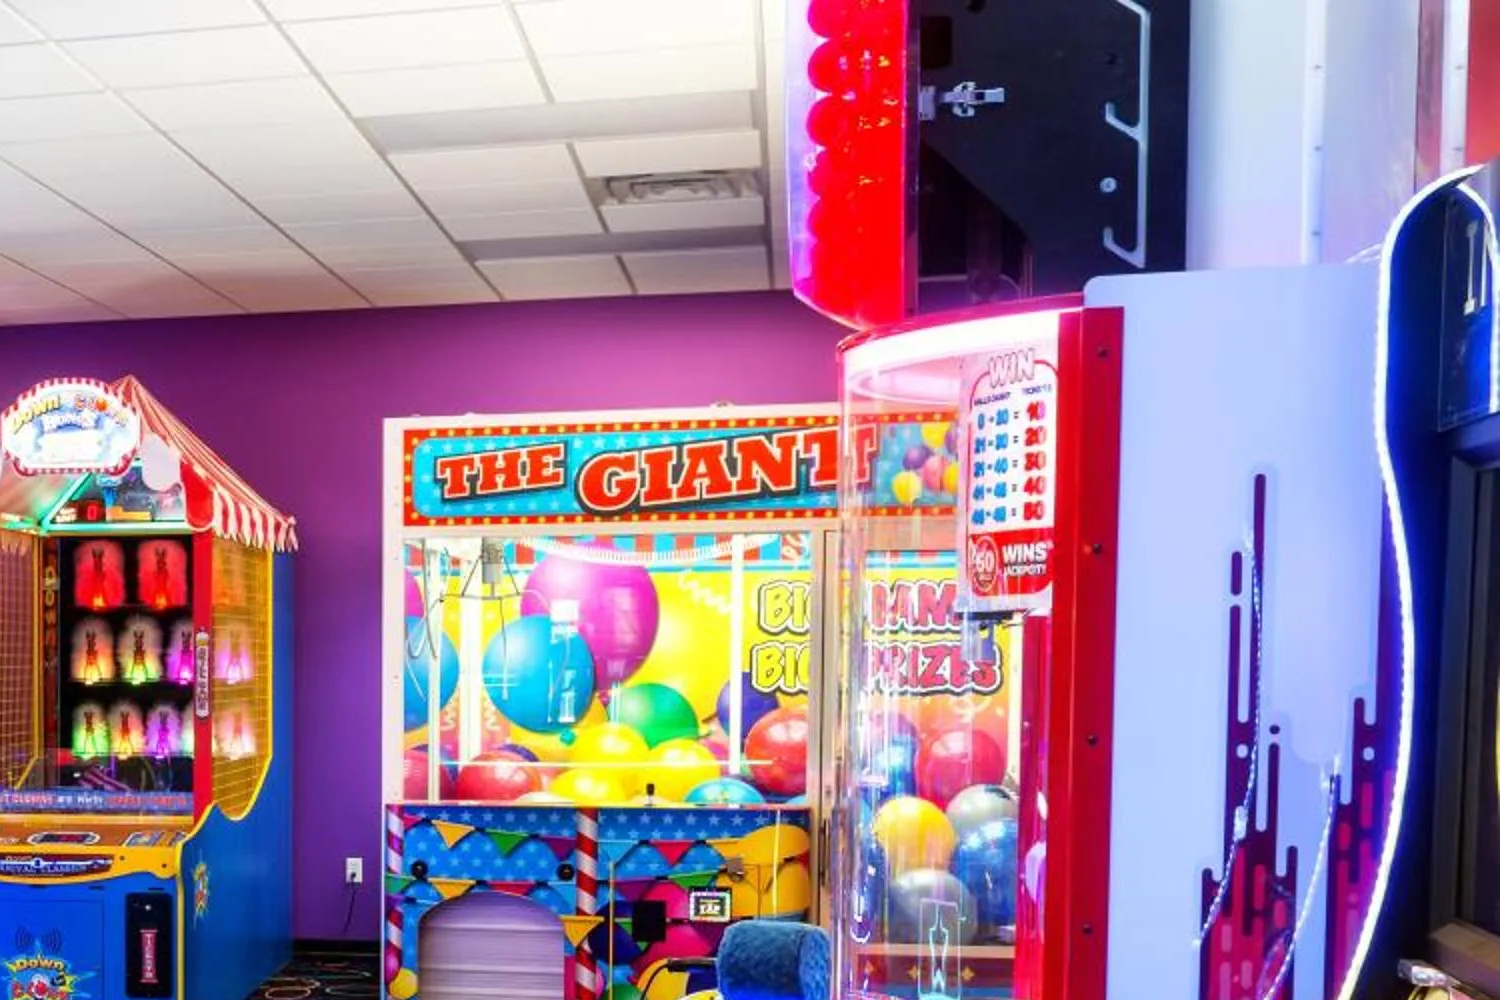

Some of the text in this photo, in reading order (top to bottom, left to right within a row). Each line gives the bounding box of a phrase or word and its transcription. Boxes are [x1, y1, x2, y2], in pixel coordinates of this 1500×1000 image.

[988, 347, 1036, 389] WIN
[436, 423, 878, 513] THE GIANT
[1002, 542, 1048, 563] WINS
